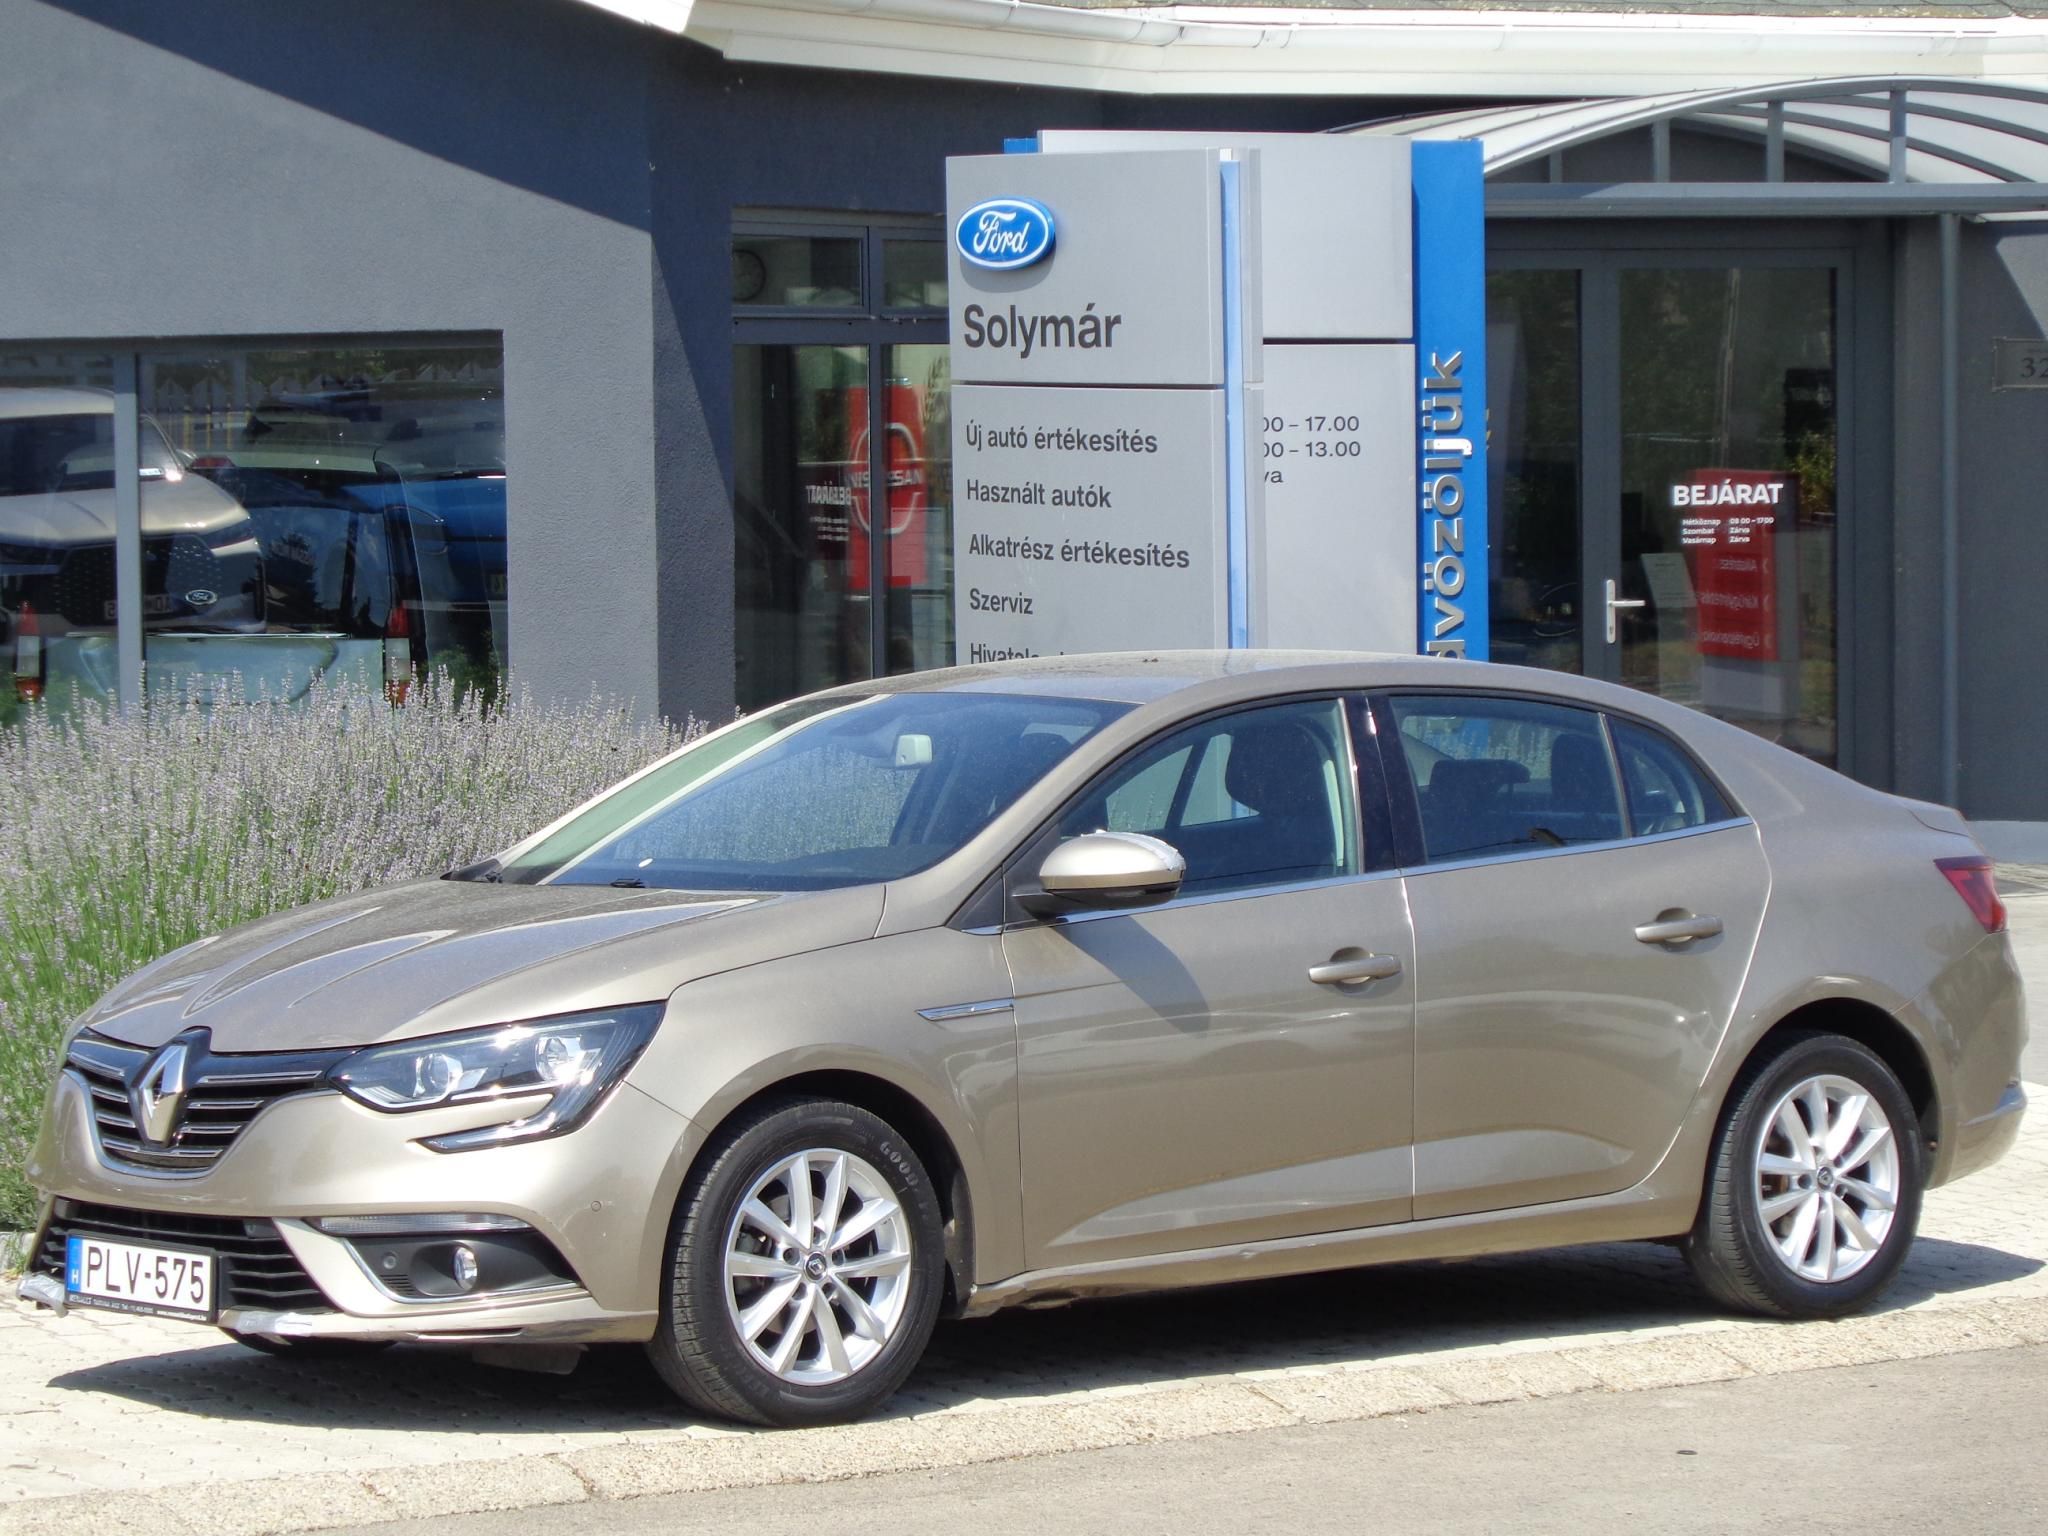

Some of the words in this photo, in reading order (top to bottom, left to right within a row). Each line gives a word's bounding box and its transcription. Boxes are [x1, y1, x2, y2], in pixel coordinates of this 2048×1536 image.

[973, 210, 1030, 254] Ford
[964, 302, 1122, 359] Solymár
[966, 419, 983, 452] Új
[987, 425, 1028, 449] autó
[1034, 426, 1159, 453] értékesítés
[1304, 415, 1360, 432] 17.00
[1304, 441, 1361, 457] 13.00
[966, 478, 1046, 505] Használt
[1051, 485, 1113, 509] autók
[1672, 478, 1785, 506] BEJÁRAT
[1681, 527, 1715, 536] Szombat
[1729, 526, 1751, 535] Zárva
[1681, 536, 1718, 545] Vasárnap
[1729, 535, 1751, 544] Zárva
[969, 533, 1055, 561] Alkatrész
[1061, 539, 1191, 569] értékesítés
[969, 587, 1034, 615] Szerviz
[71, 1269, 80, 1284] H
[86, 1246, 205, 1304] PLV-575
